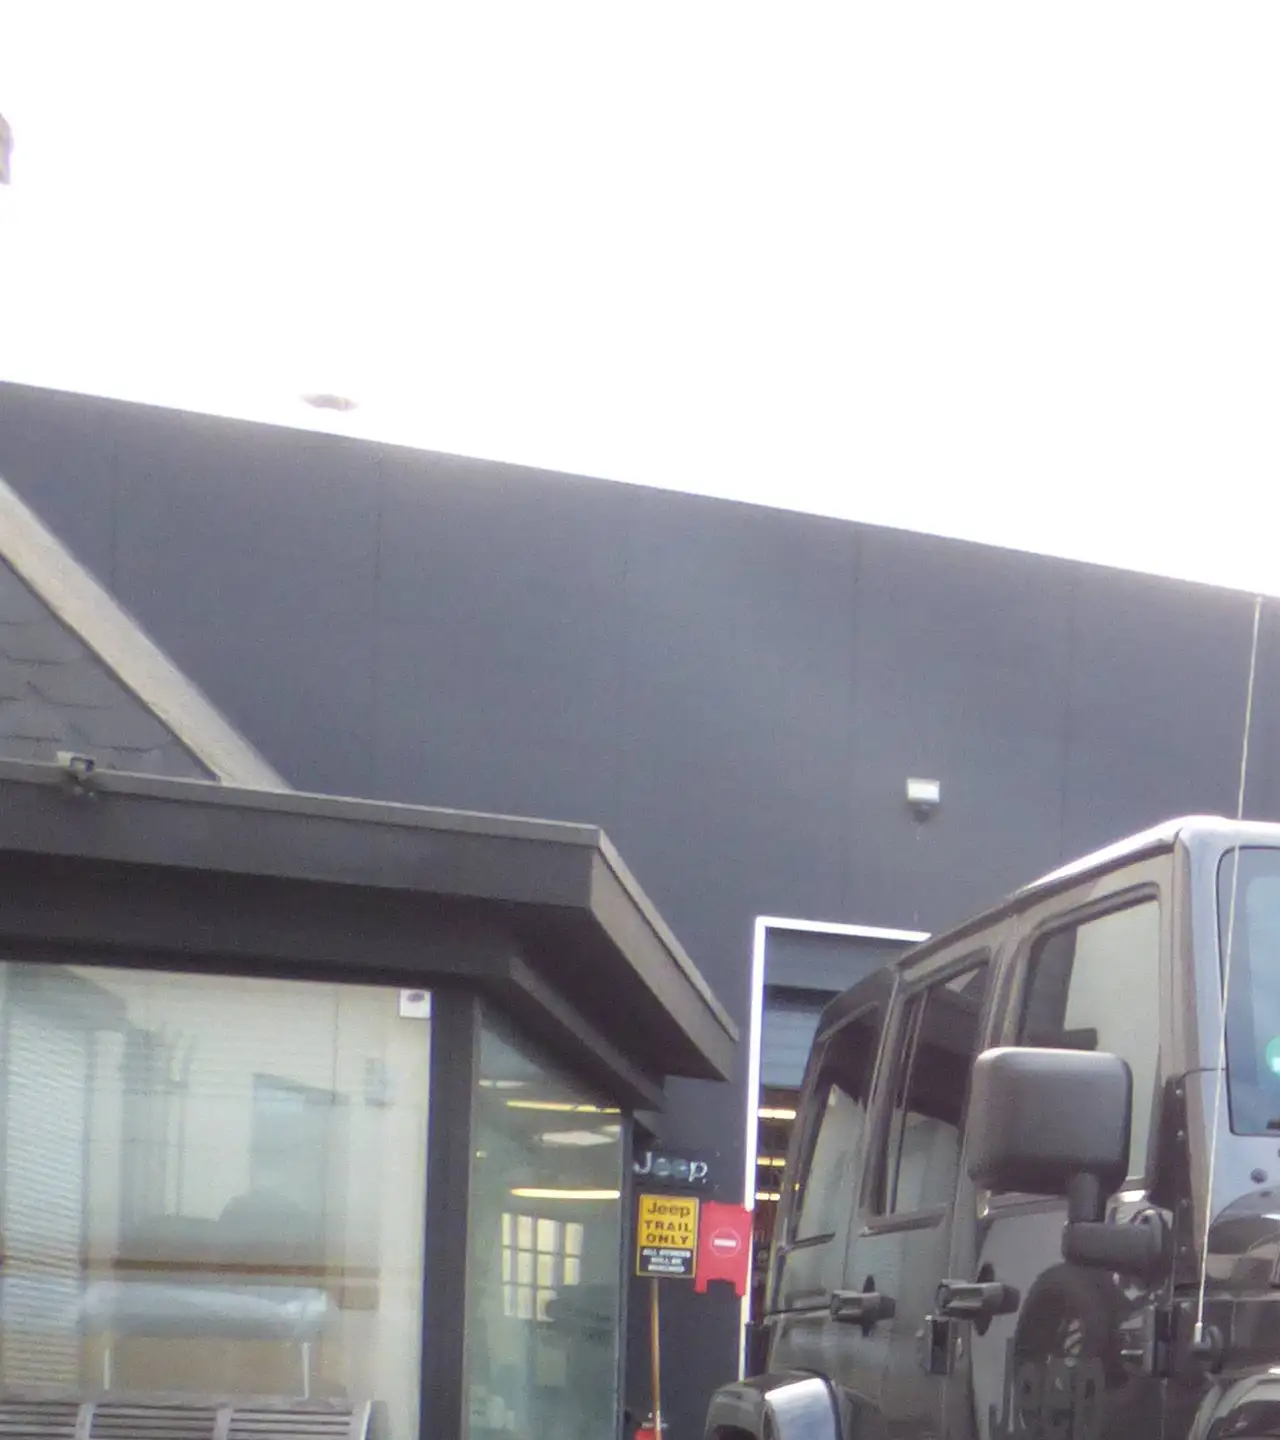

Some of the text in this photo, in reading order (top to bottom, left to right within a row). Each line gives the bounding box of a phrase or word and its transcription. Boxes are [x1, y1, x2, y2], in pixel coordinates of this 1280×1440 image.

[632, 1151, 708, 1182] Jeep
[647, 1201, 691, 1219] Jeep
[644, 1220, 691, 1233] TRAIL
[646, 1233, 689, 1246] ONLY
